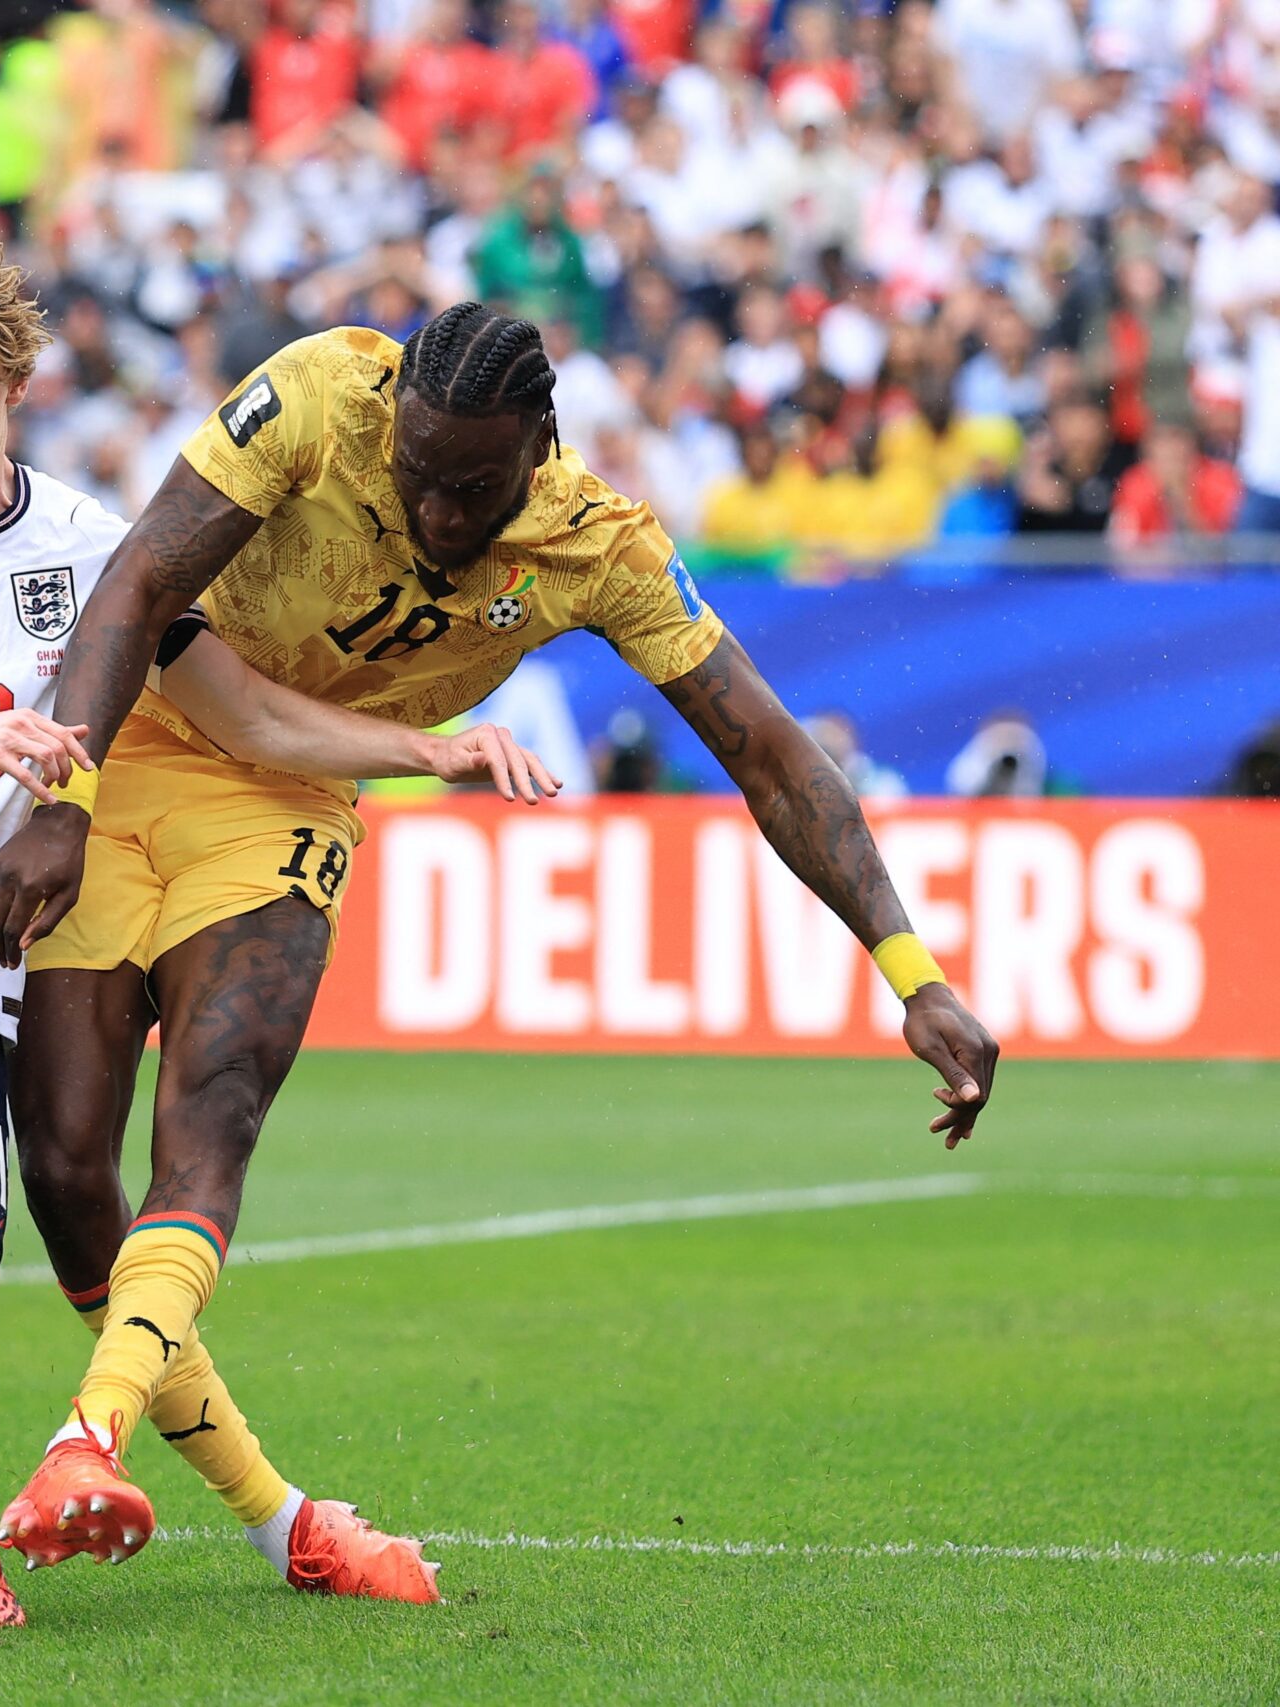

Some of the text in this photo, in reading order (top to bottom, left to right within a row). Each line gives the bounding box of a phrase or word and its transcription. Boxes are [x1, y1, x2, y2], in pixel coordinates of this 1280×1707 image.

[36, 648, 64, 662] GHAN
[324, 582, 451, 662] 18
[278, 827, 347, 901] 18
[379, 815, 1206, 1042] DELIVERS
